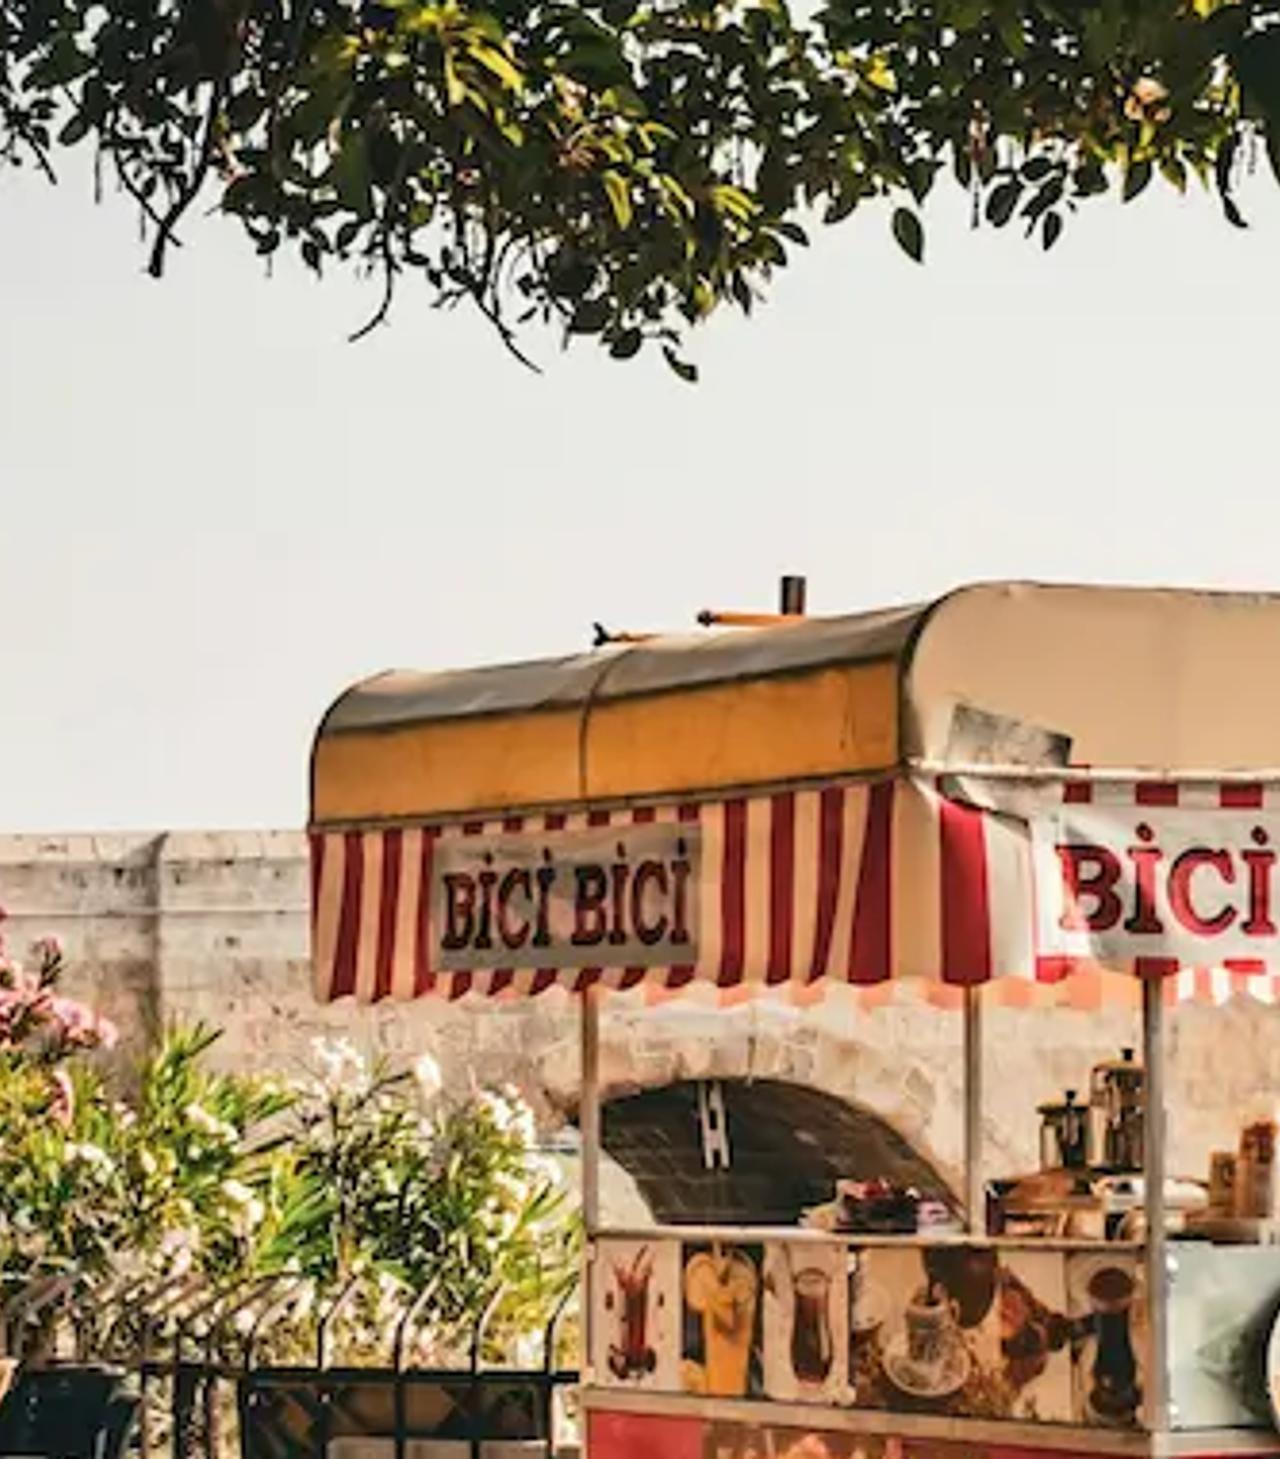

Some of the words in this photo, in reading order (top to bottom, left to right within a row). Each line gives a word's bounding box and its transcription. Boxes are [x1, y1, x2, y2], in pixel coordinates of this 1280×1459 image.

[441, 846, 556, 950] BİCİ
[570, 837, 692, 946] BİCİ
[1054, 822, 1277, 936] BİCİ
